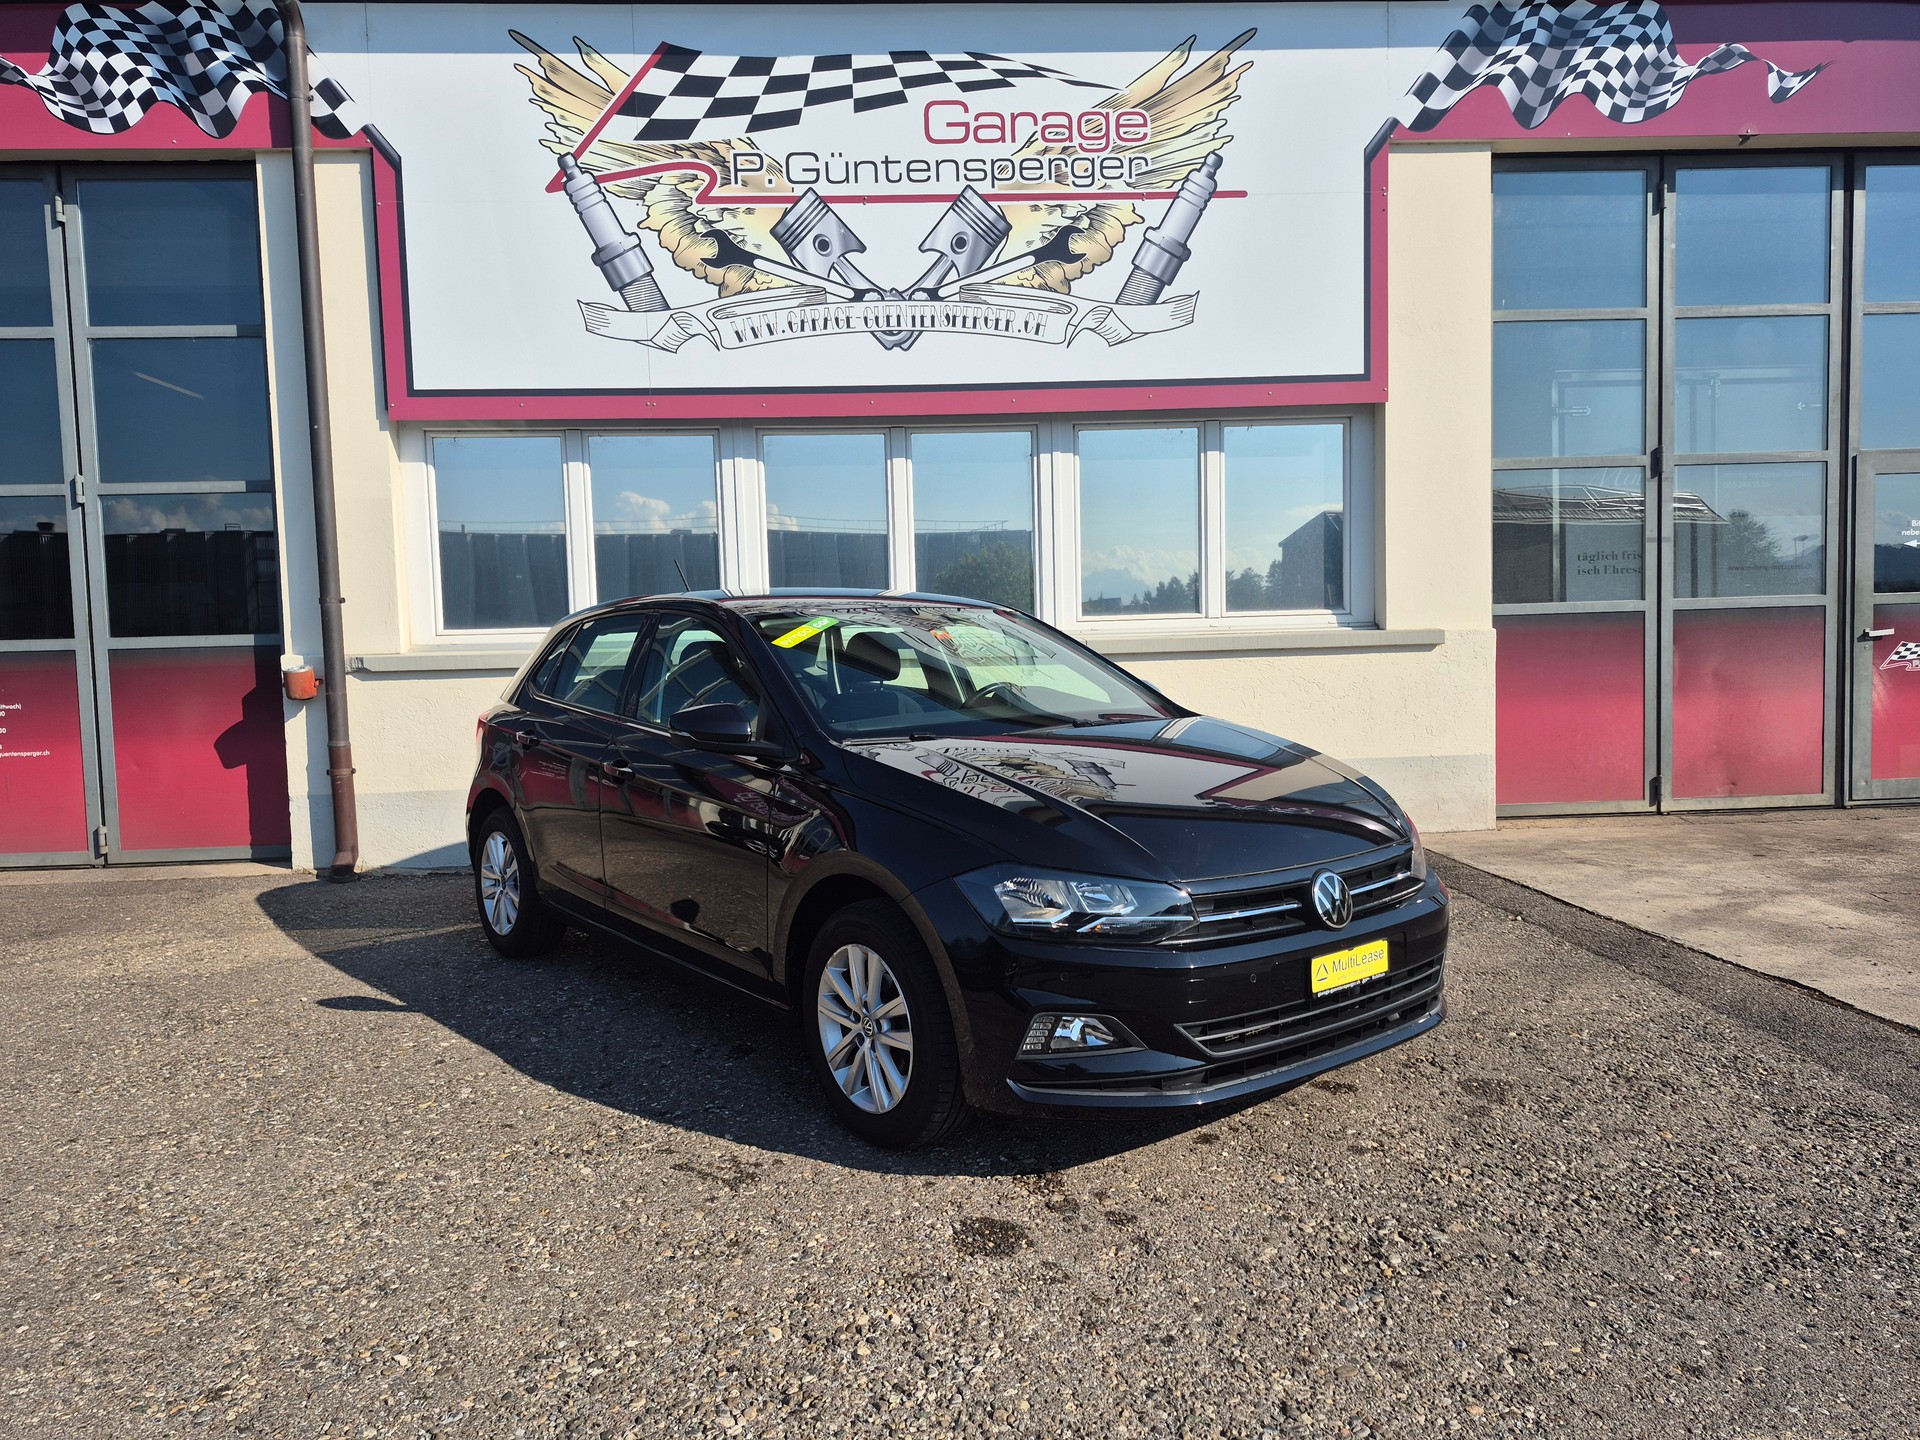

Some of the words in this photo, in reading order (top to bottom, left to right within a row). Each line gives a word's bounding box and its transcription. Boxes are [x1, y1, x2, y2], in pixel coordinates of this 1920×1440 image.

[923, 99, 1149, 154] Garage
[732, 152, 774, 185] P.
[785, 151, 1149, 189] Güntensperger
[729, 304, 1048, 343] WWW.GARAGE-GUENTENSPERGER.CH
[1577, 551, 1618, 564] täglich
[1577, 565, 1600, 576] isch
[1331, 949, 1385, 974] MultiLease
